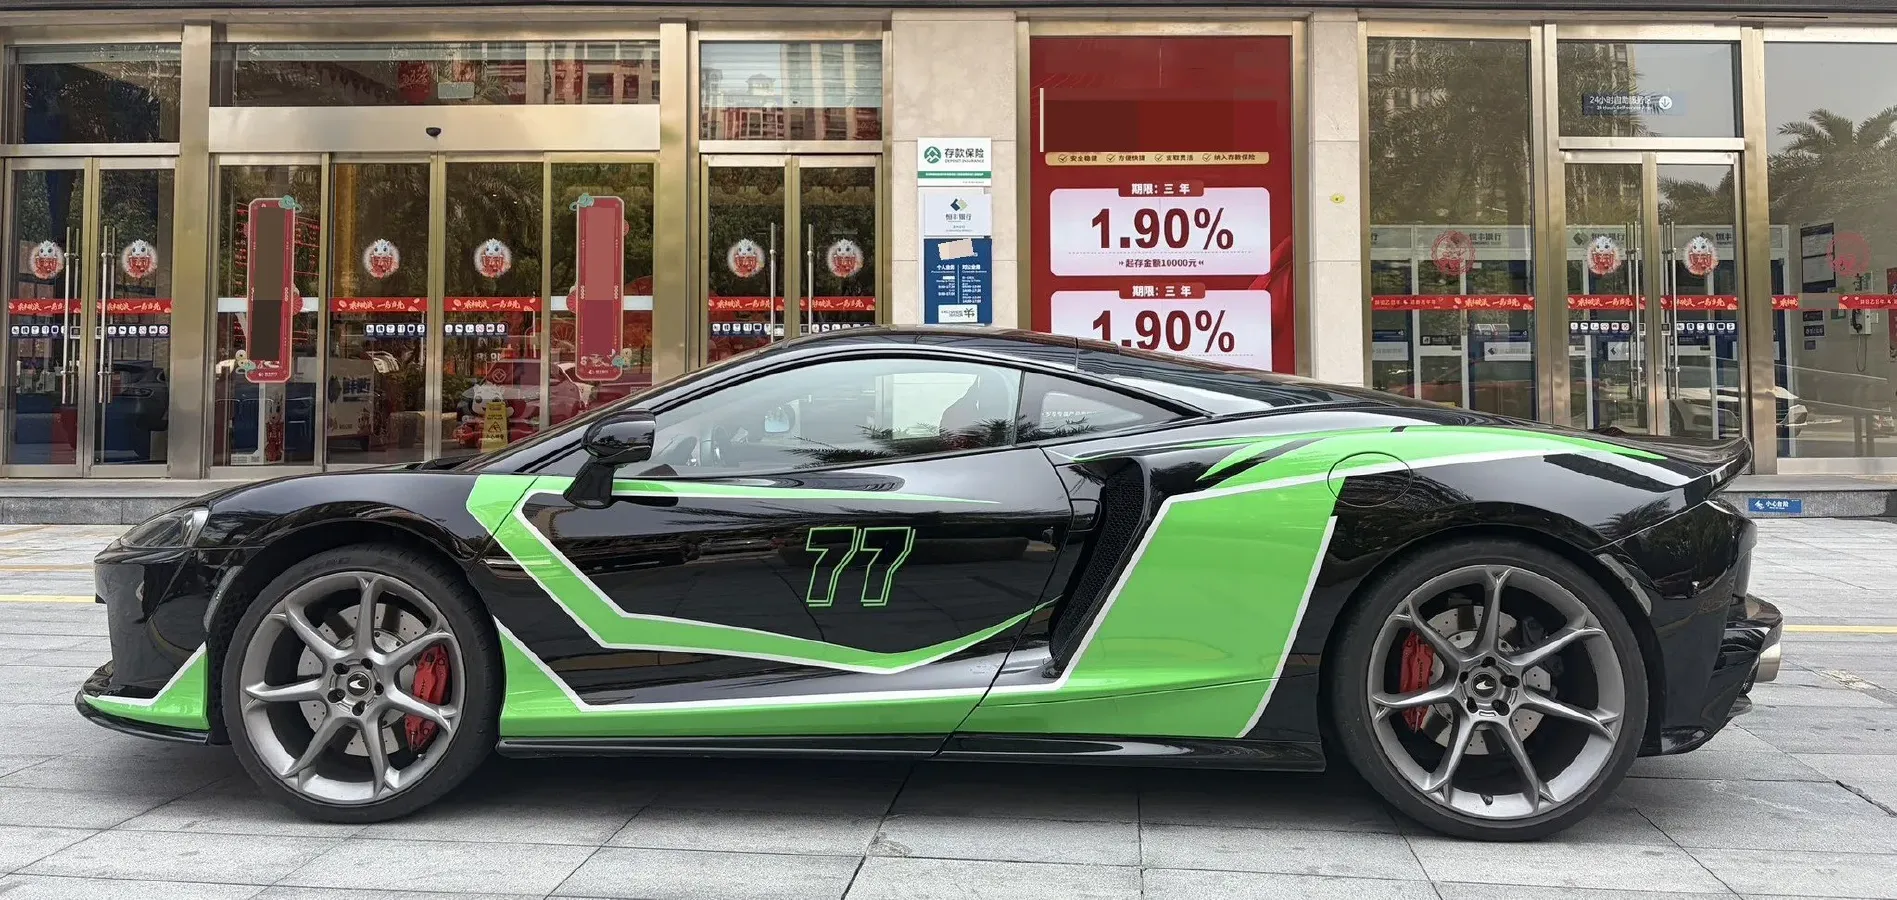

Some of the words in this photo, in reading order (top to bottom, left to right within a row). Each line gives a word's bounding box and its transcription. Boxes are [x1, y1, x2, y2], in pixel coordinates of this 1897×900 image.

[945, 148, 984, 158] 存款保险
[1091, 207, 1234, 250] 1.90%
[1125, 258, 1197, 268] 起存金额10000元
[1092, 310, 1235, 353] 1.90%
[805, 526, 916, 607] 77
